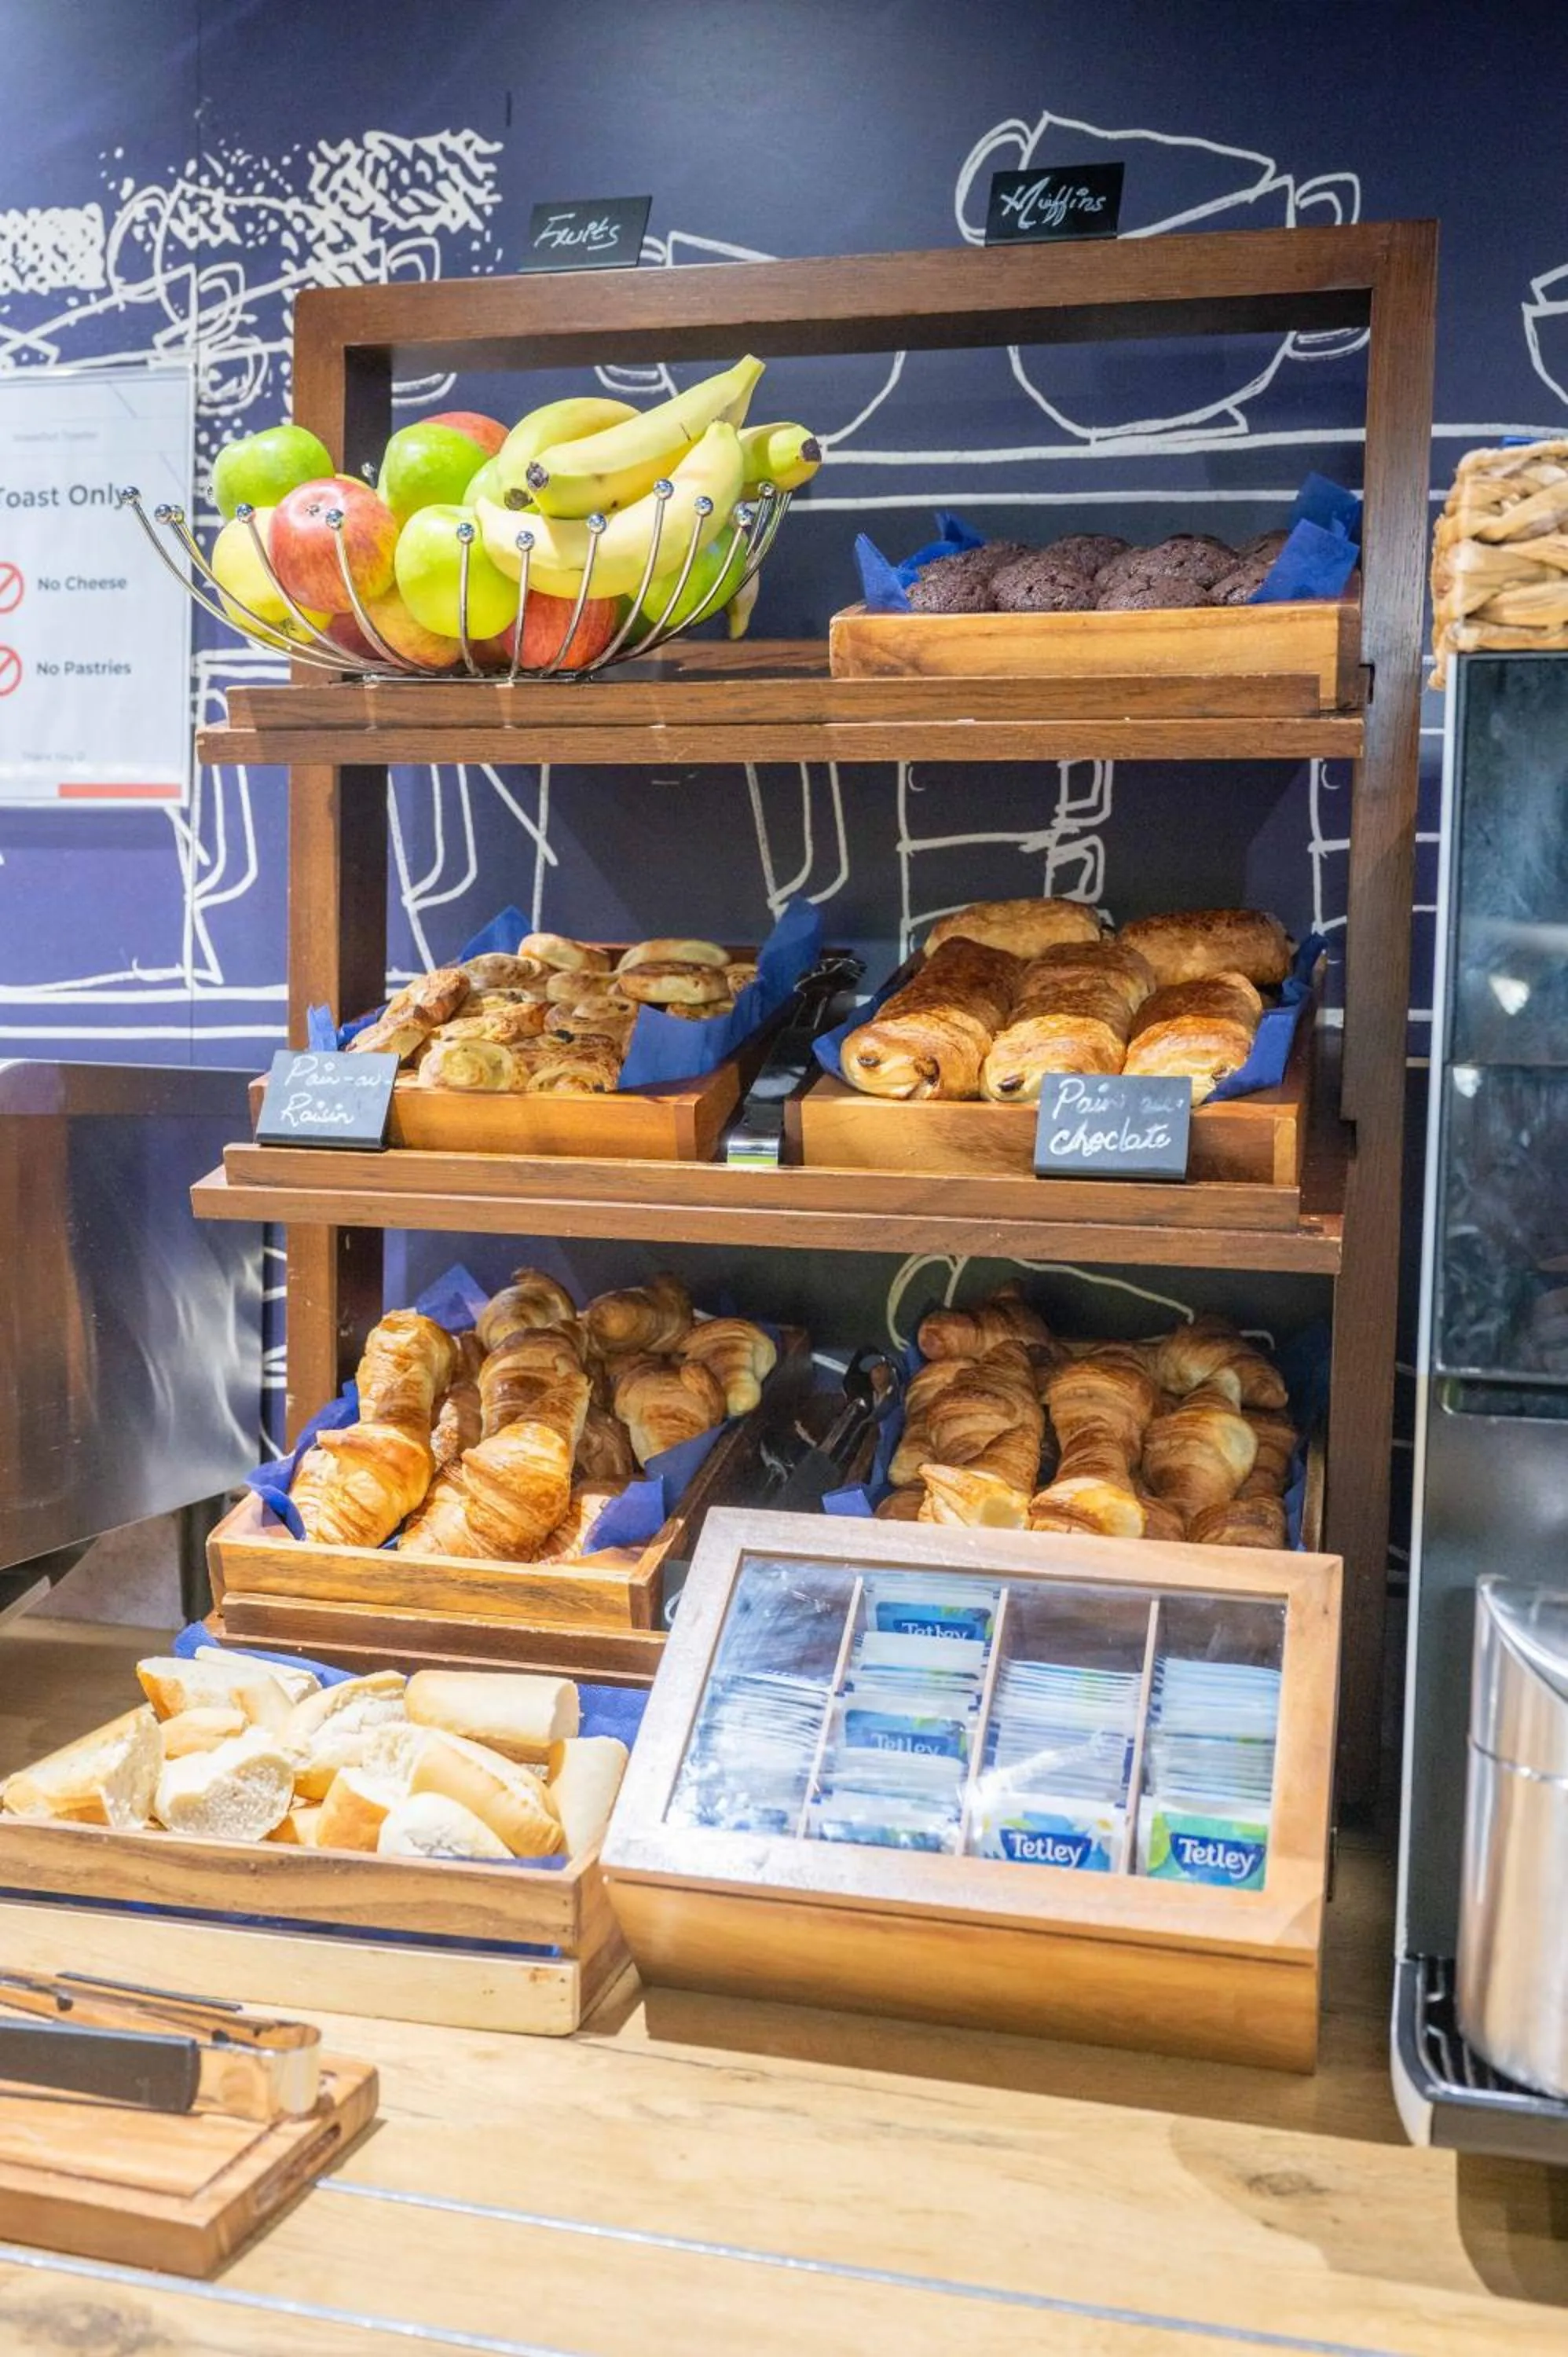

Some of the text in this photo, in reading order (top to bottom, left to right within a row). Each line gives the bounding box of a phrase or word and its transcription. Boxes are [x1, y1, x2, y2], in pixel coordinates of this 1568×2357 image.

[1000, 176, 1106, 229] Muffins
[533, 211, 621, 251] Fruits
[68, 482, 123, 511] Only
[37, 575, 127, 591] No Cheese
[36, 658, 132, 676] No Pastries
[280, 1092, 355, 1127] Raisin
[1008, 1832, 1083, 1868] Tetley
[1178, 1837, 1256, 1880] Tetley
